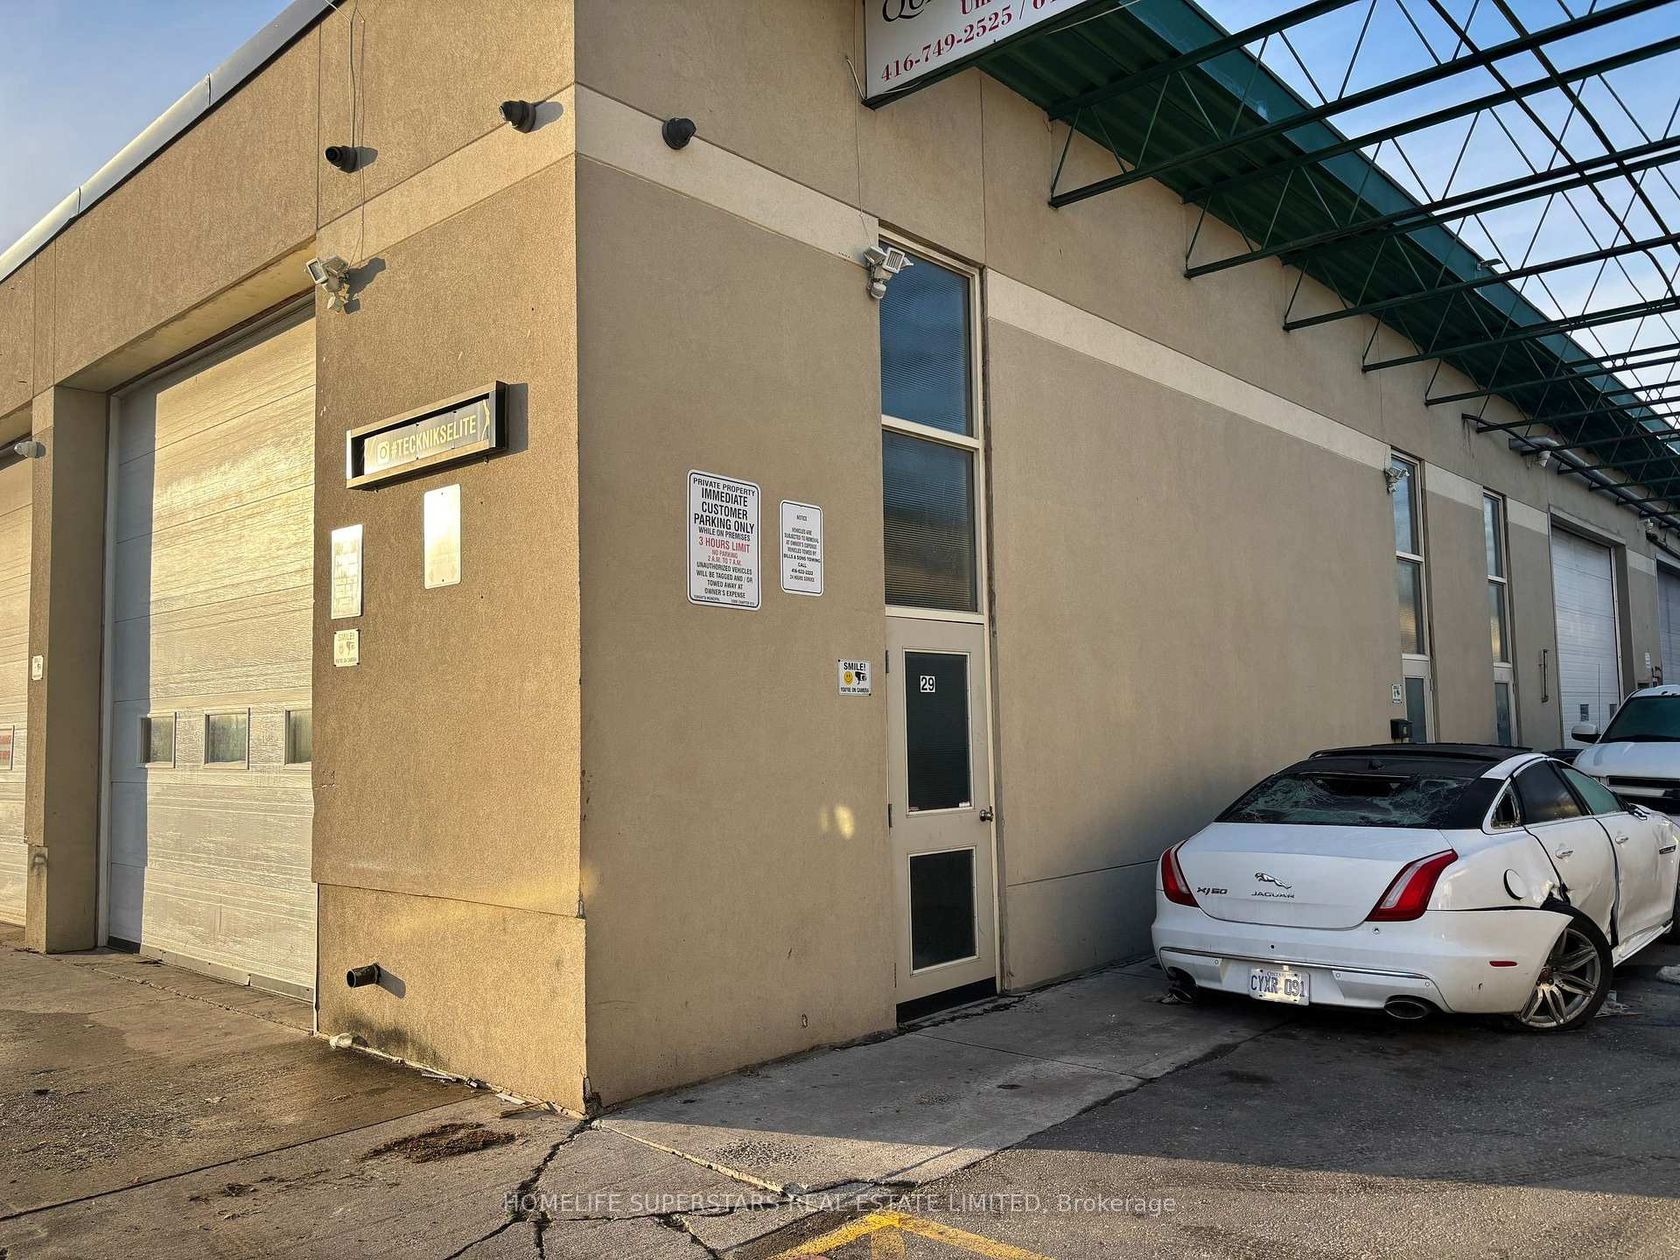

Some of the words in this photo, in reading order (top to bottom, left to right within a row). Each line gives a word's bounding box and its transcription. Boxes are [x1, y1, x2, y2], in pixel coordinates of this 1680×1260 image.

[881, 4, 1012, 81] 416-749-2525
[693, 477, 721, 490] PRIVATE
[722, 483, 756, 497] PROPERTY
[701, 488, 748, 507] IMMEDIATE
[701, 501, 748, 521] CUSTOMER
[694, 513, 732, 530] PARKING
[734, 520, 755, 534] ONLY
[698, 526, 716, 536] WHILE
[725, 530, 751, 542] PREMISES
[698, 536, 704, 546] 3
[705, 538, 730, 550] HOURS
[732, 542, 750, 554] LIMIT
[696, 561, 732, 572] UNAUTHORIZED
[732, 566, 752, 576] VEHICLES
[844, 662, 866, 671] SMILE!
[921, 677, 935, 691] 29
[1251, 890, 1295, 899] JAGUAR
